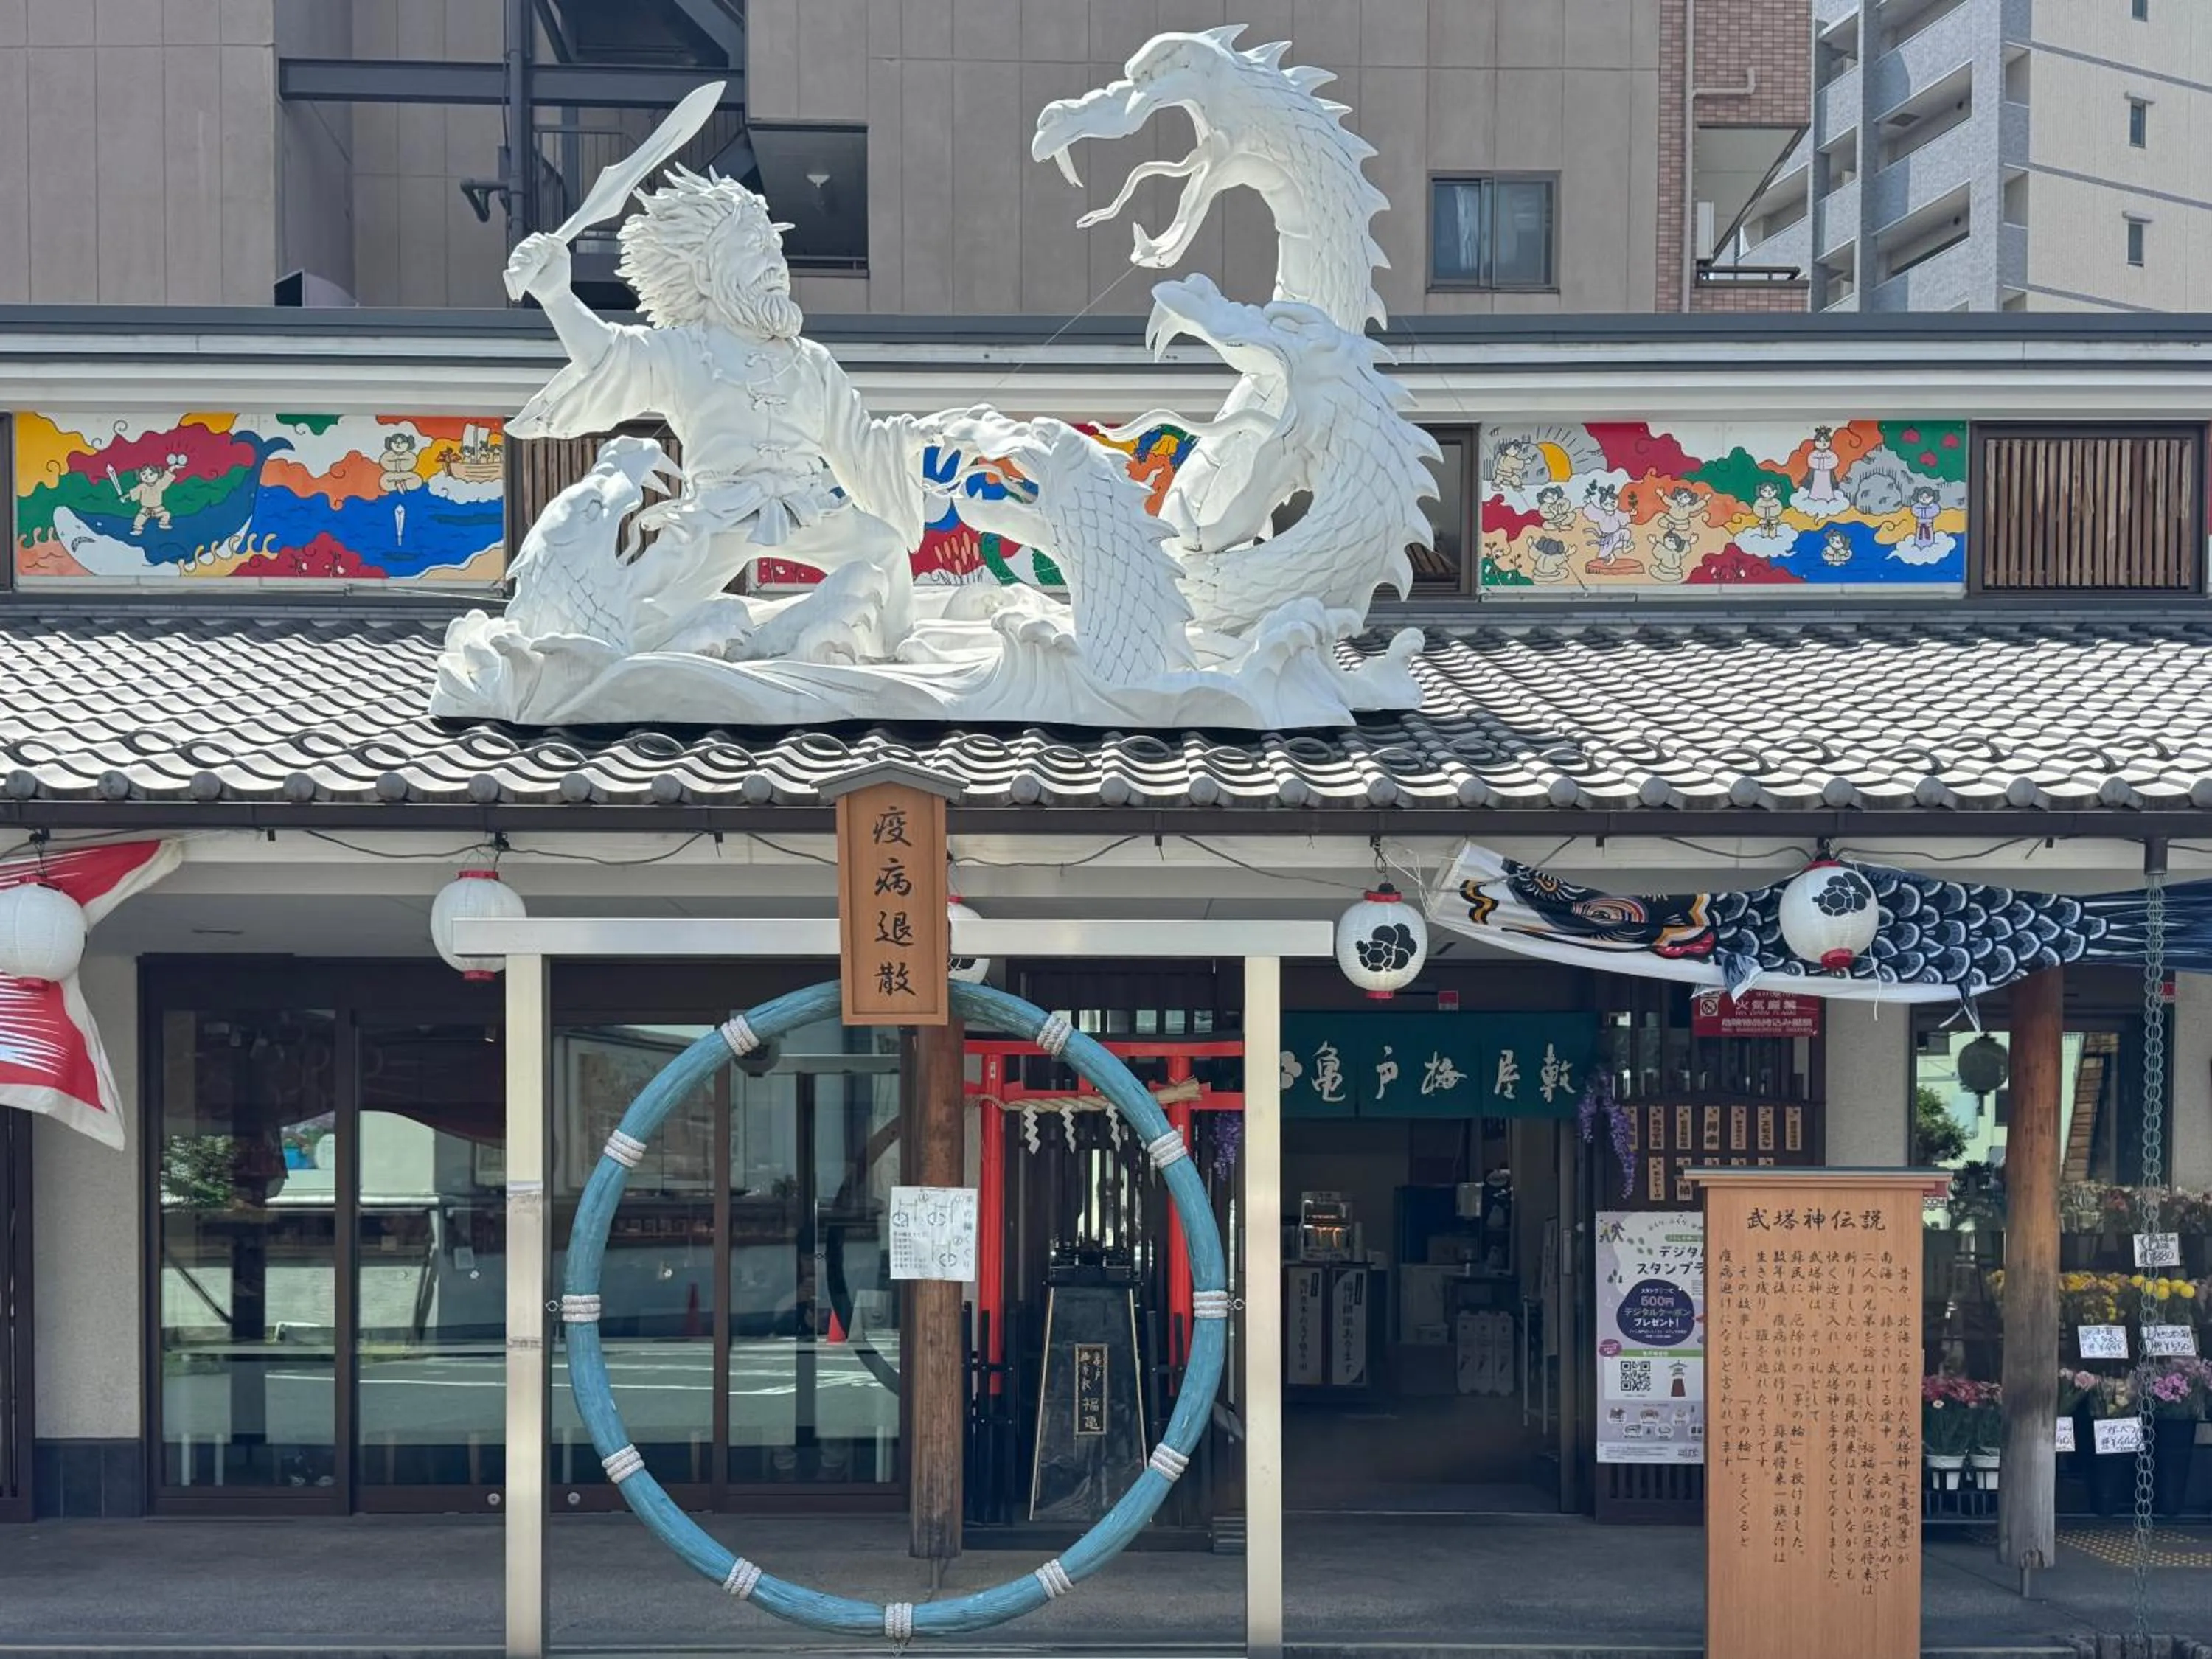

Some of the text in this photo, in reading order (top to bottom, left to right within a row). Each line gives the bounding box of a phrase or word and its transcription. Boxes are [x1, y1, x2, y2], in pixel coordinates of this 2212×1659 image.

[873, 805, 917, 996] 疫病退散
[1746, 1208, 1886, 1231] 武塔神伝説
[1641, 1295, 1674, 1307] 500円
